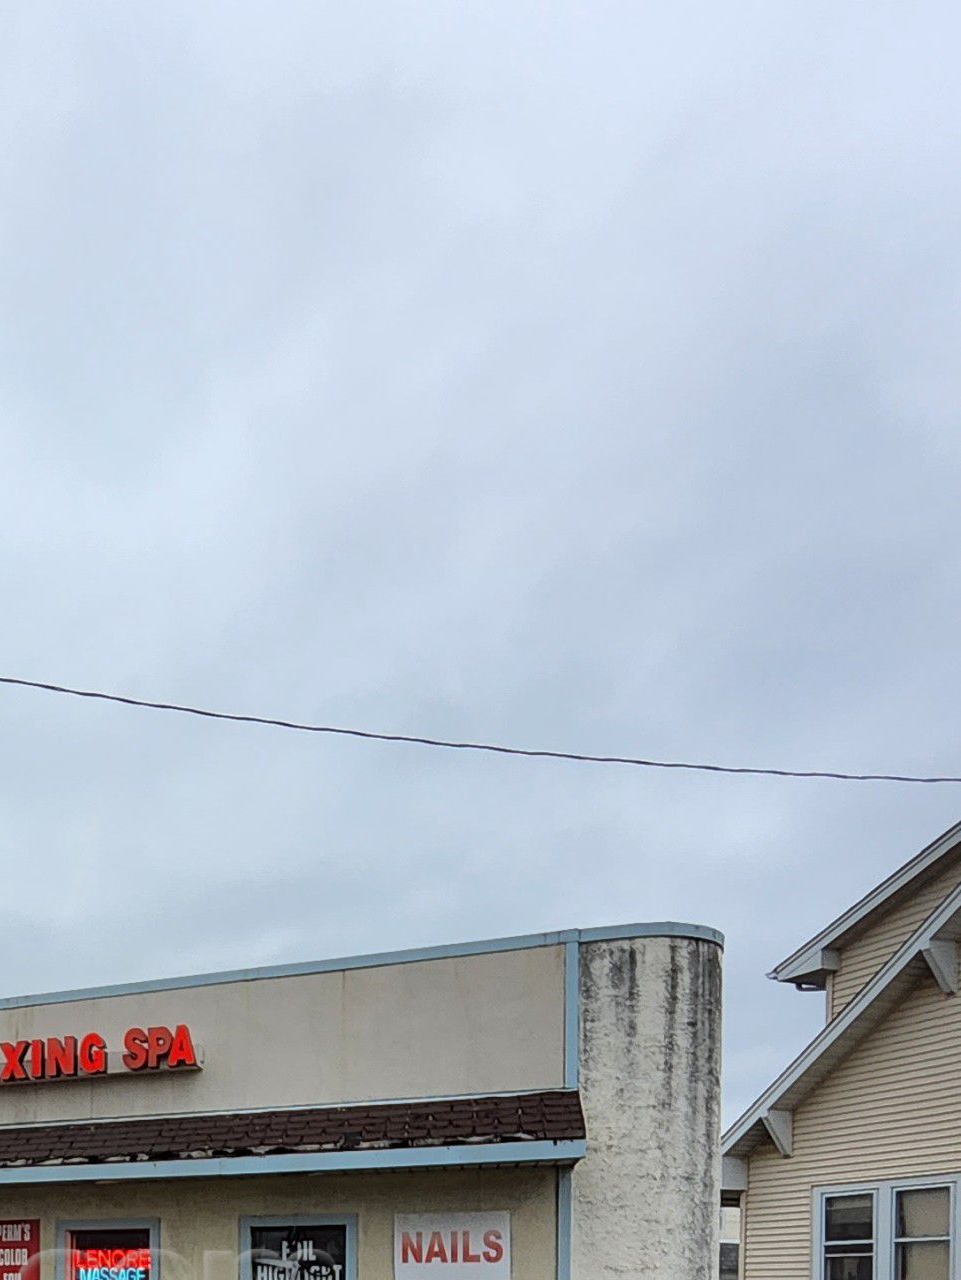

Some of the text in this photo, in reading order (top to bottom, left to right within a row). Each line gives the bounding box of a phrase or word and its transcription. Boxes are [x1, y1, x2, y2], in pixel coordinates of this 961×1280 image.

[122, 1023, 196, 1070] SPA
[75, 1249, 151, 1269] LENORE
[401, 1229, 504, 1264] NAILS
